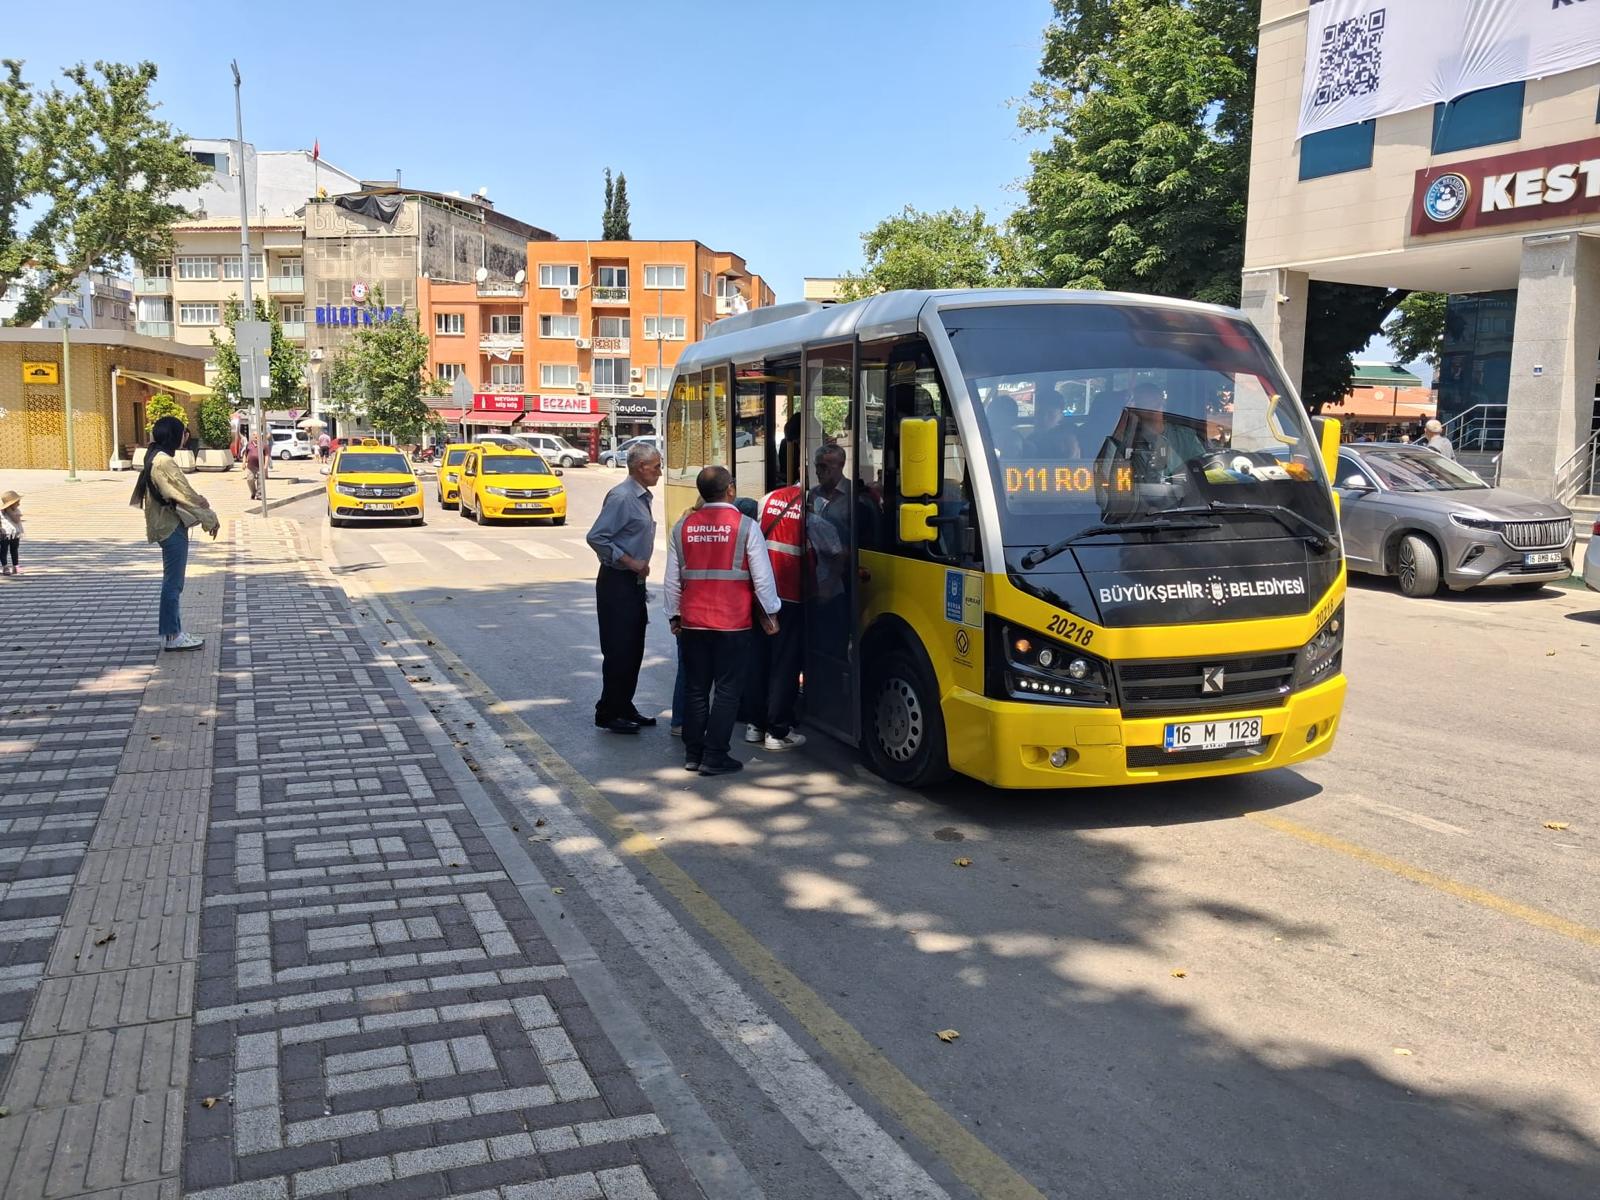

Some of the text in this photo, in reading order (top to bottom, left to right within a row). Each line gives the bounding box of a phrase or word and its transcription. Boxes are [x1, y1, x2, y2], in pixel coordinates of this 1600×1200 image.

[316, 303, 359, 325] BİLGE
[543, 398, 587, 409] ECZANE
[1006, 467, 1047, 491] D11
[687, 525, 731, 533] BURULAŞ
[687, 534, 729, 543] DENETİM
[1100, 576, 1305, 603] BÜYÜKŞEHİR BELEDİYESİ
[1315, 598, 1333, 629] 20218
[1046, 614, 1094, 646] 20218
[1176, 720, 1259, 744] 16 M 1128
